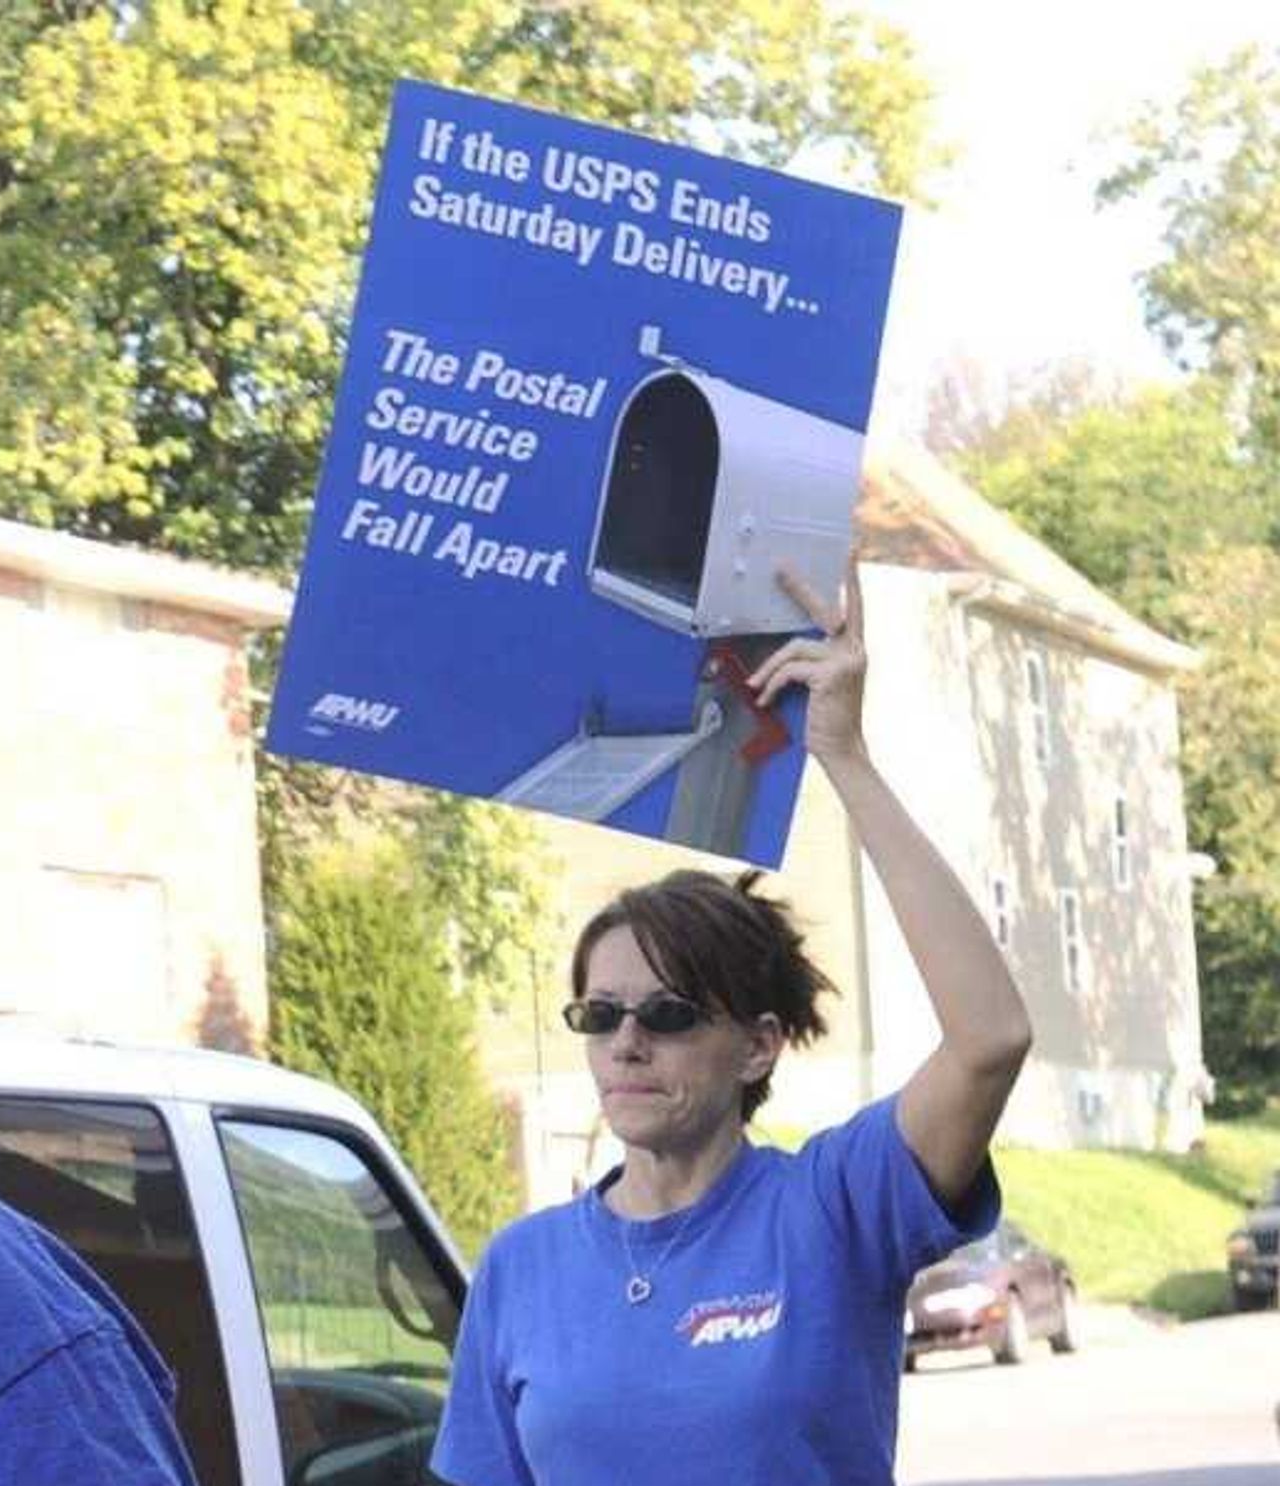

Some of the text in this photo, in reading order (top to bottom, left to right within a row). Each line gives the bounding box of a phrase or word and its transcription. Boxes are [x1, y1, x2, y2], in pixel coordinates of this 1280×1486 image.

[418, 119, 772, 243] If the USPS Ends
[410, 174, 819, 314] Saturday Delivery...
[381, 329, 608, 418] The Postal
[366, 388, 539, 461] Service
[358, 442, 510, 514] Would
[342, 499, 568, 587] Fall Apart
[312, 692, 401, 730] APWU
